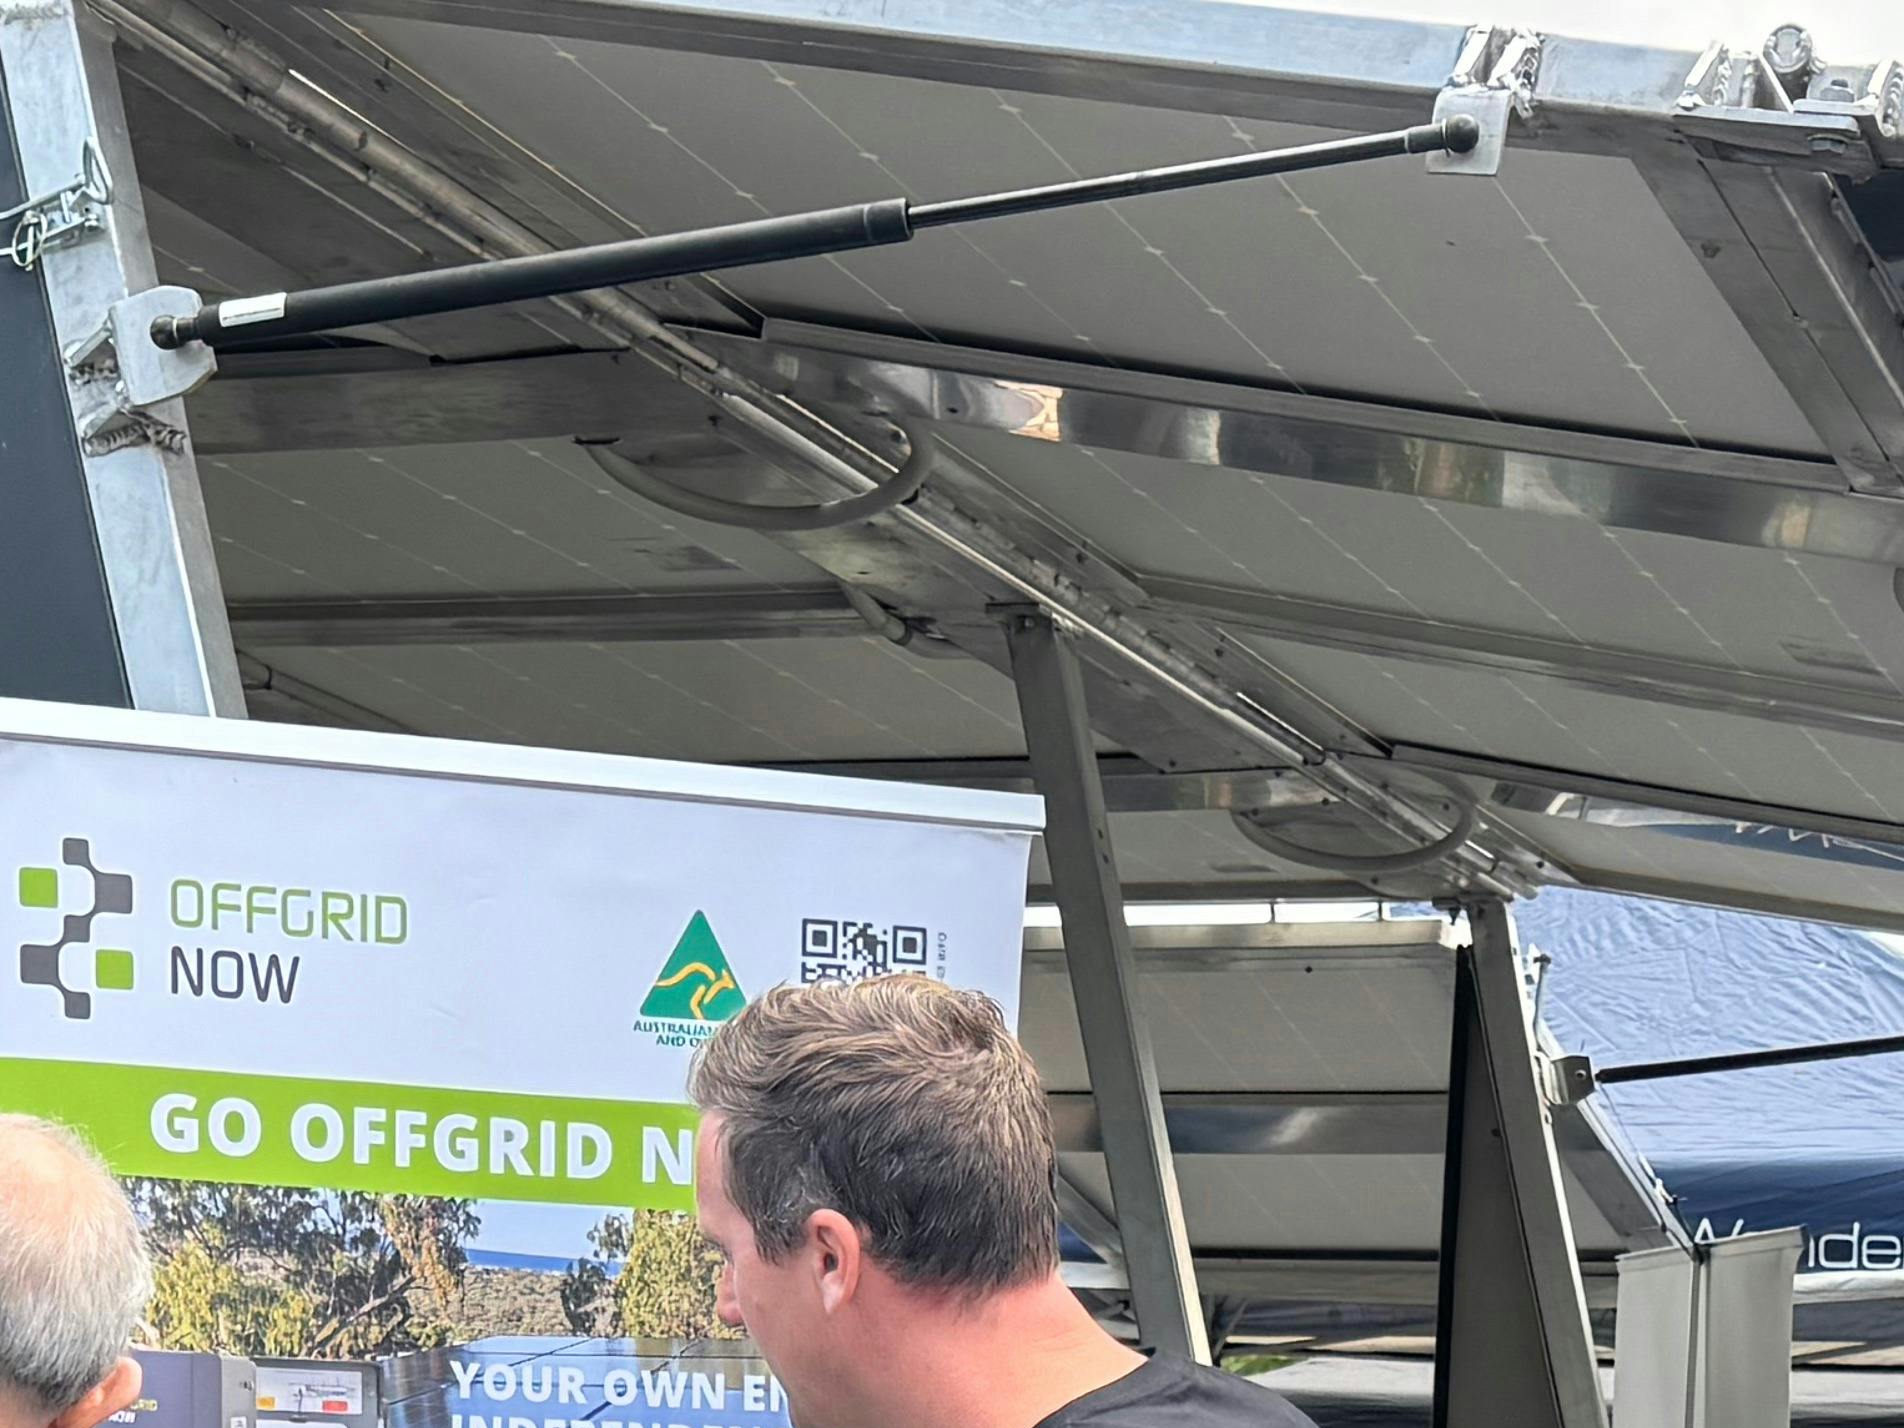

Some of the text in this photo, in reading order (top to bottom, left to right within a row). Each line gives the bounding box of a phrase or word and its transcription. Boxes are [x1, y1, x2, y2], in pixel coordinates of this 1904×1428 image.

[170, 878, 409, 945] OFFGRID
[170, 945, 301, 1005] NOW
[656, 1035, 685, 1046] AND
[149, 1093, 261, 1157] GO
[292, 1102, 612, 1182] OFFGRID
[449, 1360, 587, 1404] YOUR
[603, 1369, 726, 1411] OWN
